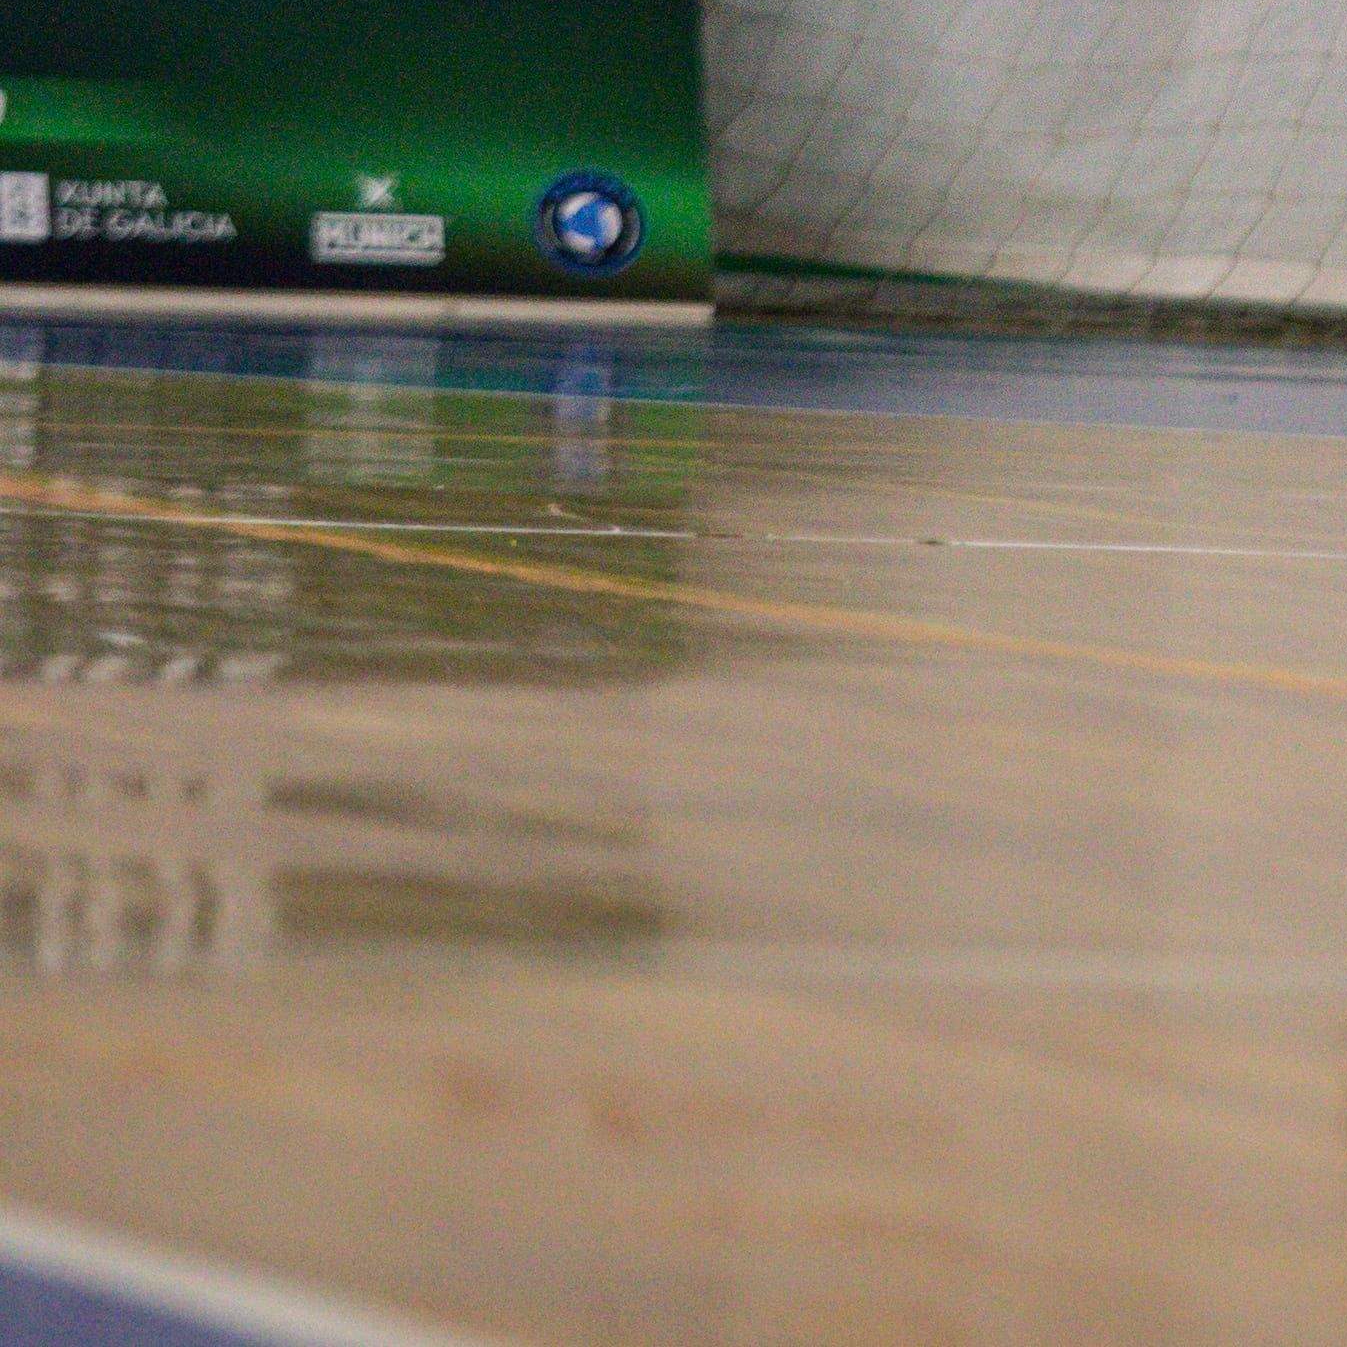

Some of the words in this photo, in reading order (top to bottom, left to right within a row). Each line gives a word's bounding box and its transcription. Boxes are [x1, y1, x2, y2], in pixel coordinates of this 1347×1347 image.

[56, 179, 168, 208] XUNTA
[56, 208, 100, 237] DE
[104, 210, 239, 242] GALICIA
